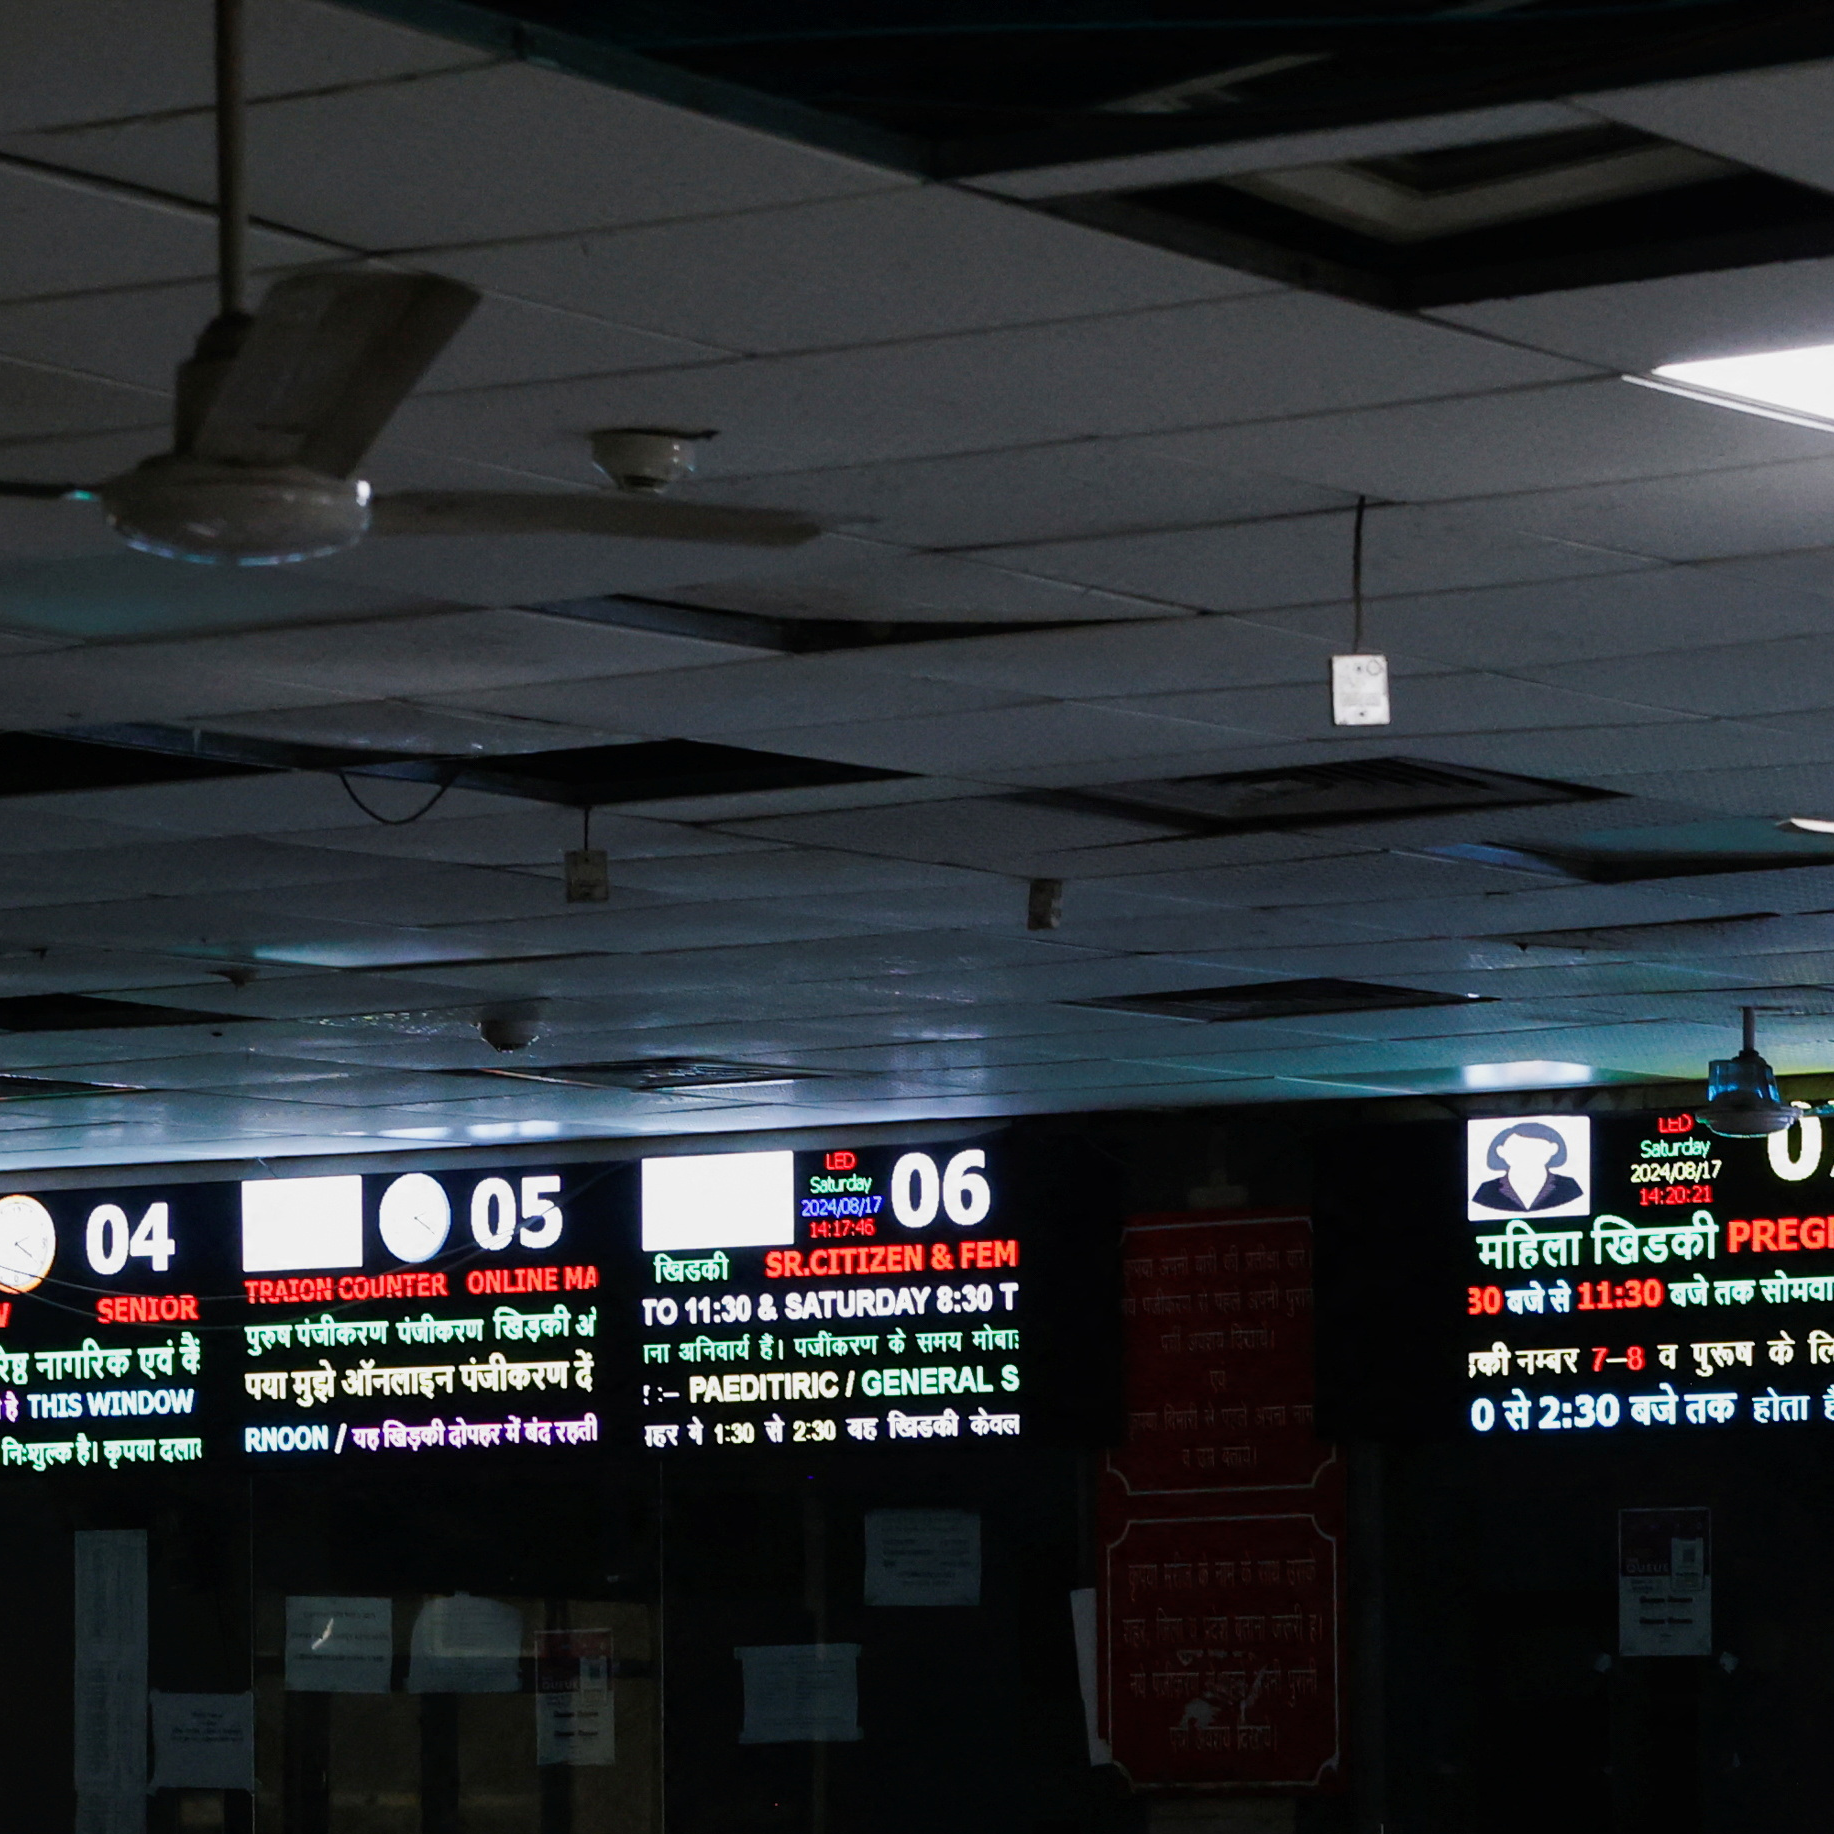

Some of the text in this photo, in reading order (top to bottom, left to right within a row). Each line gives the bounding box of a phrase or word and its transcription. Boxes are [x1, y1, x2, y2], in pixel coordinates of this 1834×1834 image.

[1659, 1114, 1692, 1133] LED
[825, 1151, 856, 1170] LED
[1641, 1138, 1710, 1158] Saturday
[810, 1174, 872, 1194] Saturday
[891, 1149, 990, 1228] 06
[1631, 1160, 1722, 1184] 2024/08/17
[471, 1176, 562, 1250] 05
[801, 1195, 884, 1219] 2024/08/17
[1640, 1185, 1712, 1206] 14:20:21
[86, 1202, 175, 1275] 04
[1476, 1218, 1583, 1269] महिला
[765, 1240, 1018, 1278] SR.CITIZEN & FEM
[338, 1266, 598, 1300] COUNTER ONLINE MA
[1505, 1281, 1545, 1314] बजे
[1549, 1279, 1571, 1313] से
[1577, 1278, 1664, 1310] 11:30
[1668, 1273, 1709, 1307] बजे
[1714, 1280, 1755, 1305] तक
[97, 1295, 199, 1324] SENIOR
[642, 1284, 992, 1326] TO 11:30 & SATURDAY 8:30
[295, 1304, 571, 1347] पंजीकरण पंजीकरण खिड़की
[34, 1338, 132, 1380] नागरिक
[137, 1339, 174, 1379] एवं
[679, 1328, 962, 1362] अनिवार्य के समय
[1516, 1349, 1580, 1374] नम्बर
[1657, 1345, 1678, 1368] व
[1767, 1330, 1795, 1365] के
[245, 1352, 569, 1407] पया मुझे ऑनलाइन पंजीकरण
[690, 1366, 993, 1403] PAEDITIRIC GENERAL
[5, 1391, 18, 1422] है
[27, 1389, 194, 1418] THIS WINDOW
[1504, 1383, 1810, 1431] से 2:30 बजे तक होता
[245, 1425, 328, 1452] RNOON
[352, 1413, 597, 1450] यह दोपहर में बंद रहती
[714, 1407, 1020, 1444] 1:30 से 2:30 यह केवल
[103, 1439, 155, 1469] कृपया
